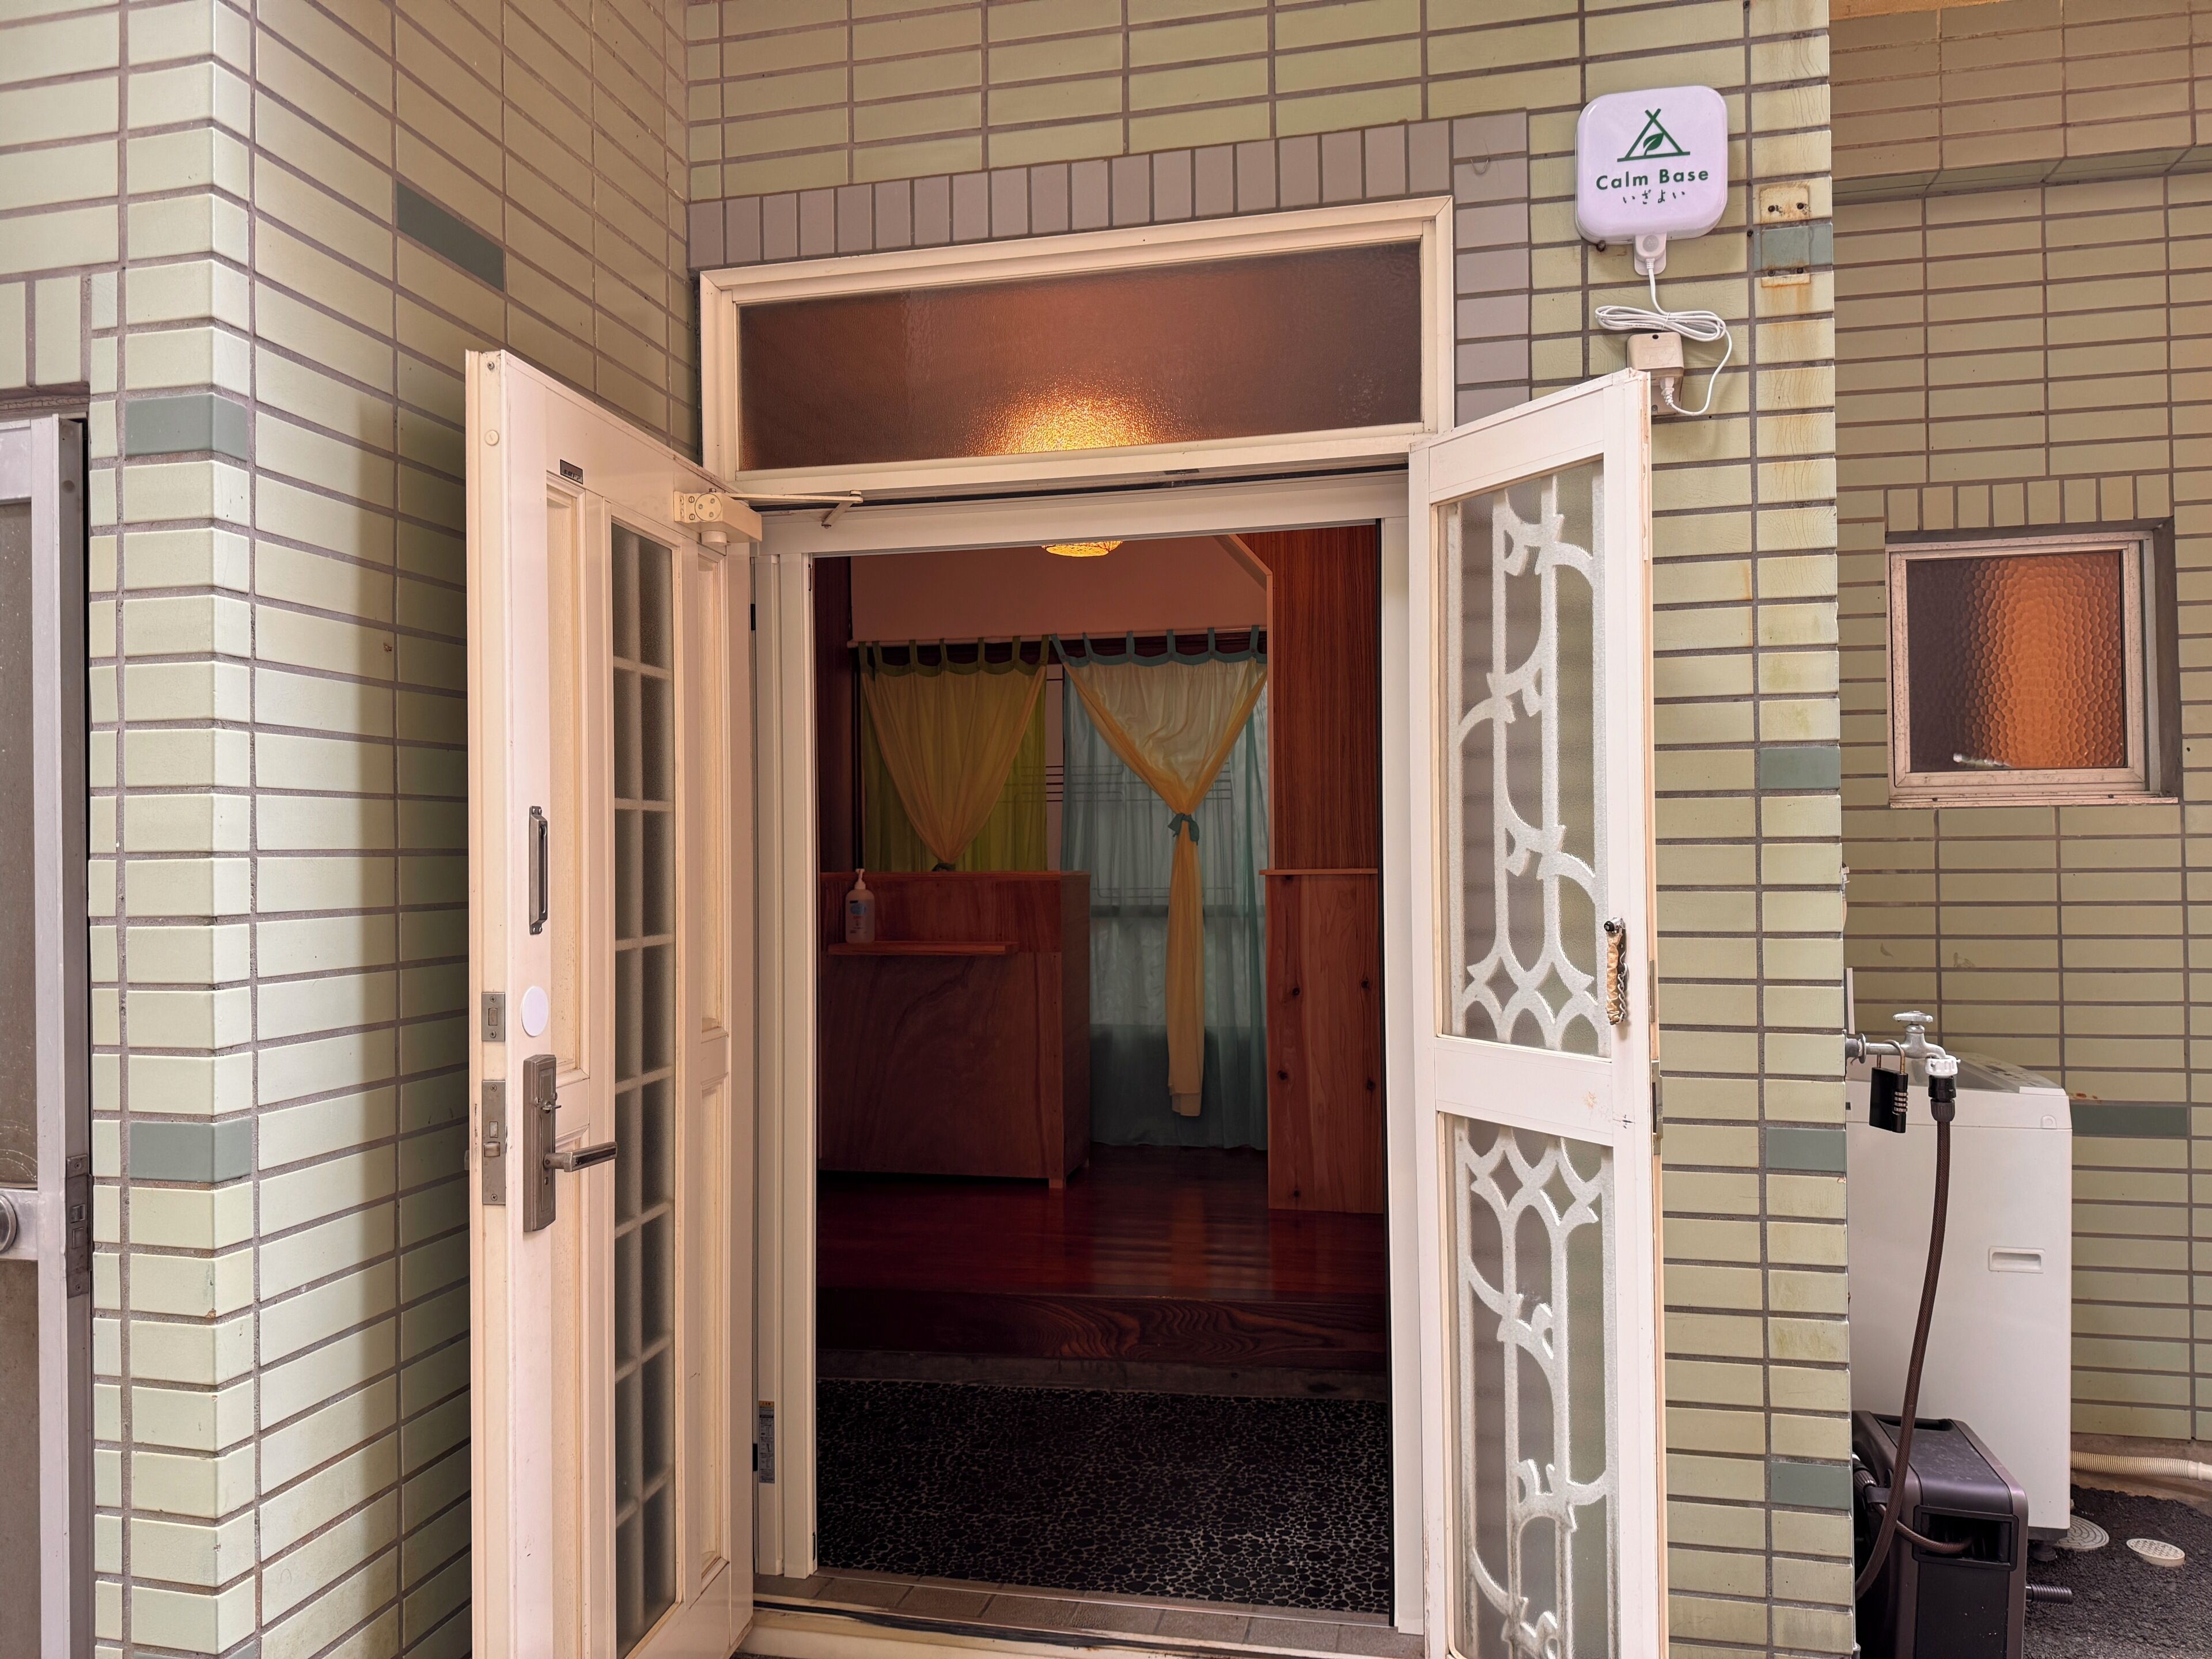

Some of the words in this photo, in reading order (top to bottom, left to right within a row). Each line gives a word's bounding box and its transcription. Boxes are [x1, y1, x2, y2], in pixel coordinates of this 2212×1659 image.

[1596, 171, 1648, 190] Calm
[1659, 169, 1709, 184] Base
[1622, 189, 1685, 204] いざよい
